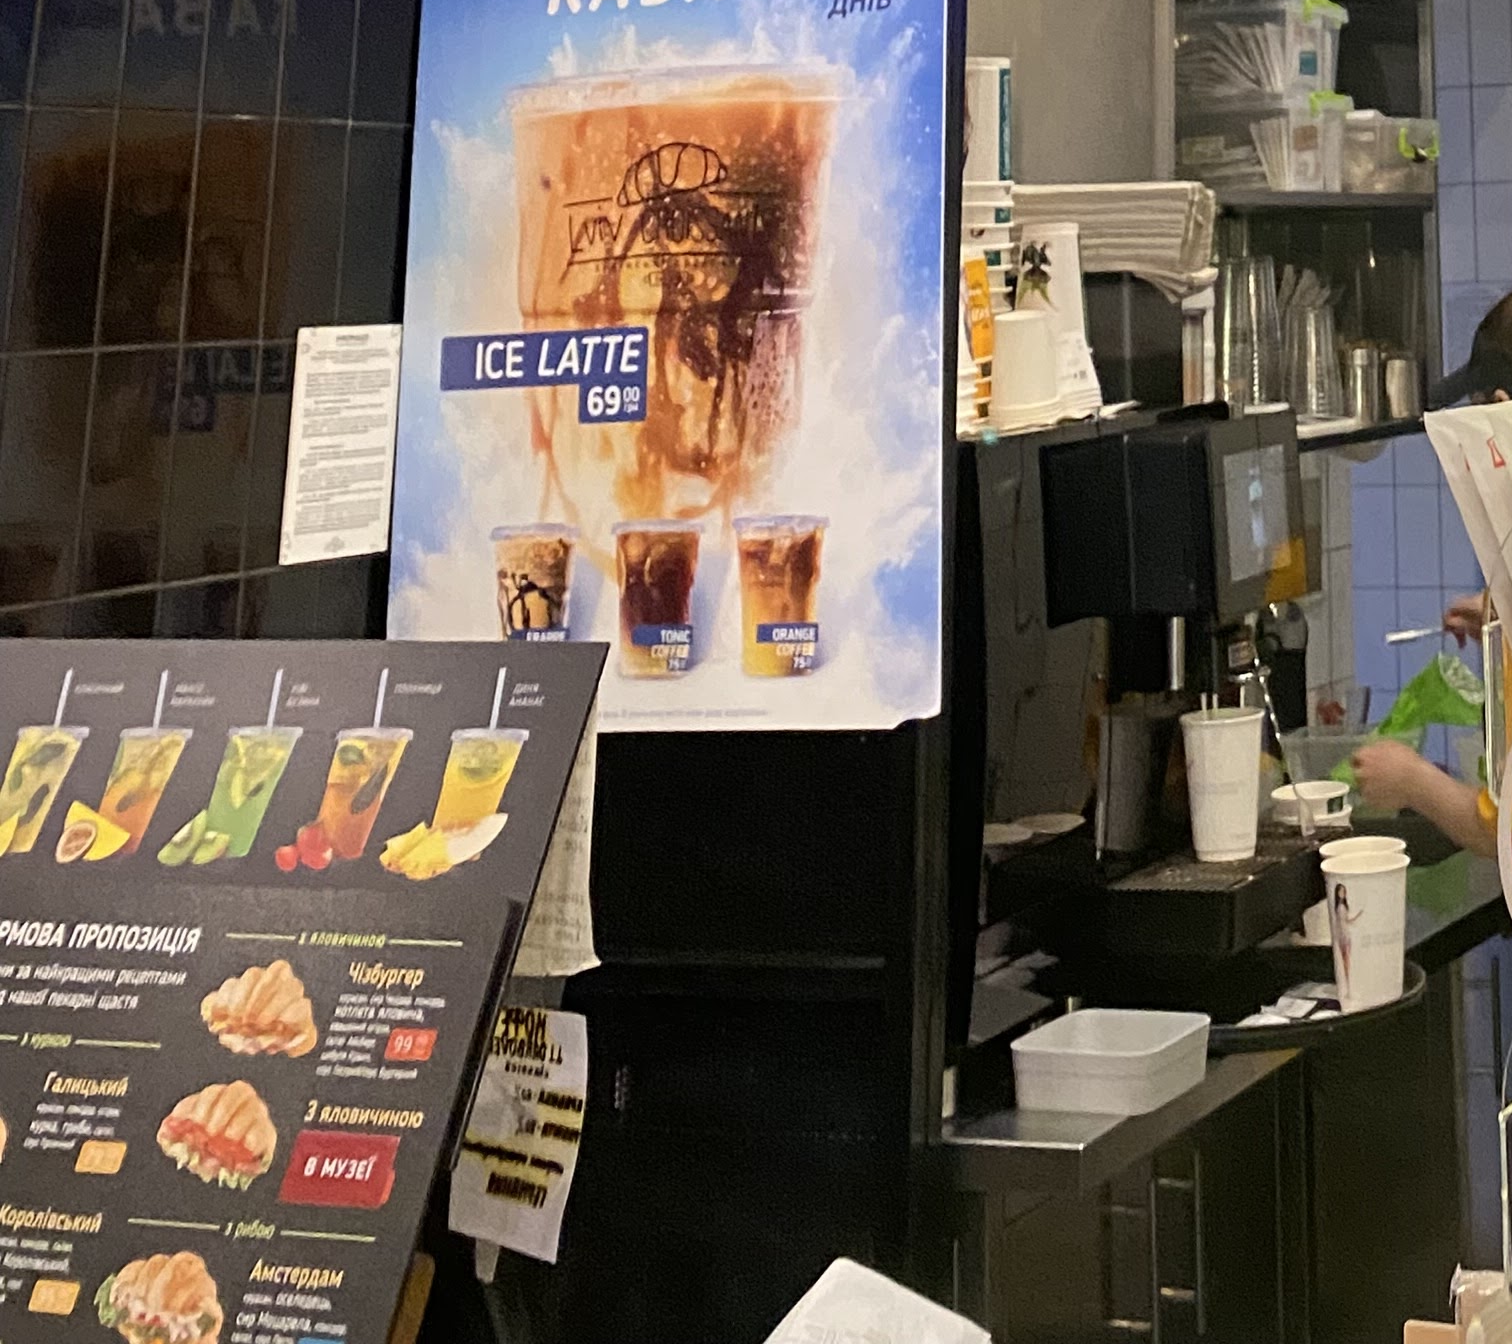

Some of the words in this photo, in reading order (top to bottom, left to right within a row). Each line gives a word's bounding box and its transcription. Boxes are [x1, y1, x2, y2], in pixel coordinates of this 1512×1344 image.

[474, 340, 523, 382] ICE
[536, 331, 642, 377] LATTE
[587, 385, 620, 416] 69
[772, 628, 816, 641] ORANGE
[0, 920, 66, 948] РМОВА
[68, 923, 202, 957] ПРОПОЗИЦІЯ
[43, 1071, 128, 1097] Галицький
[304, 1157, 316, 1176] В
[320, 1154, 377, 1182] МУЗЕЇ
[249, 1258, 344, 1290] Амстердам
